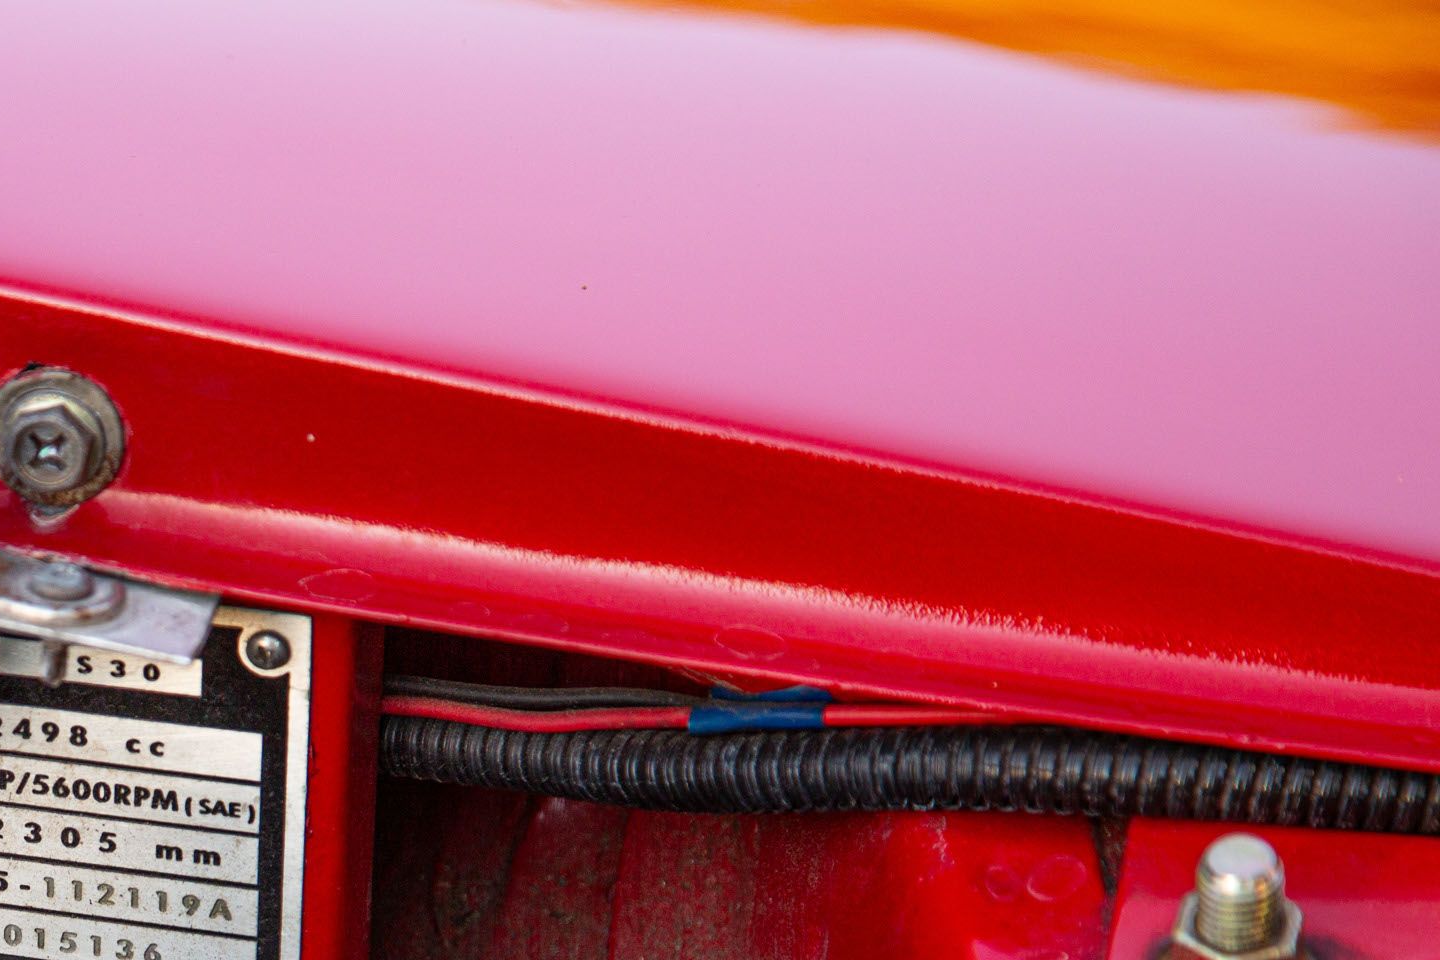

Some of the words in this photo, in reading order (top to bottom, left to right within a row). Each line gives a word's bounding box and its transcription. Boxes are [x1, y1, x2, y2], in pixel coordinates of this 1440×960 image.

[77, 655, 160, 681] S30
[126, 738, 165, 757] cc
[155, 844, 221, 866] mm
